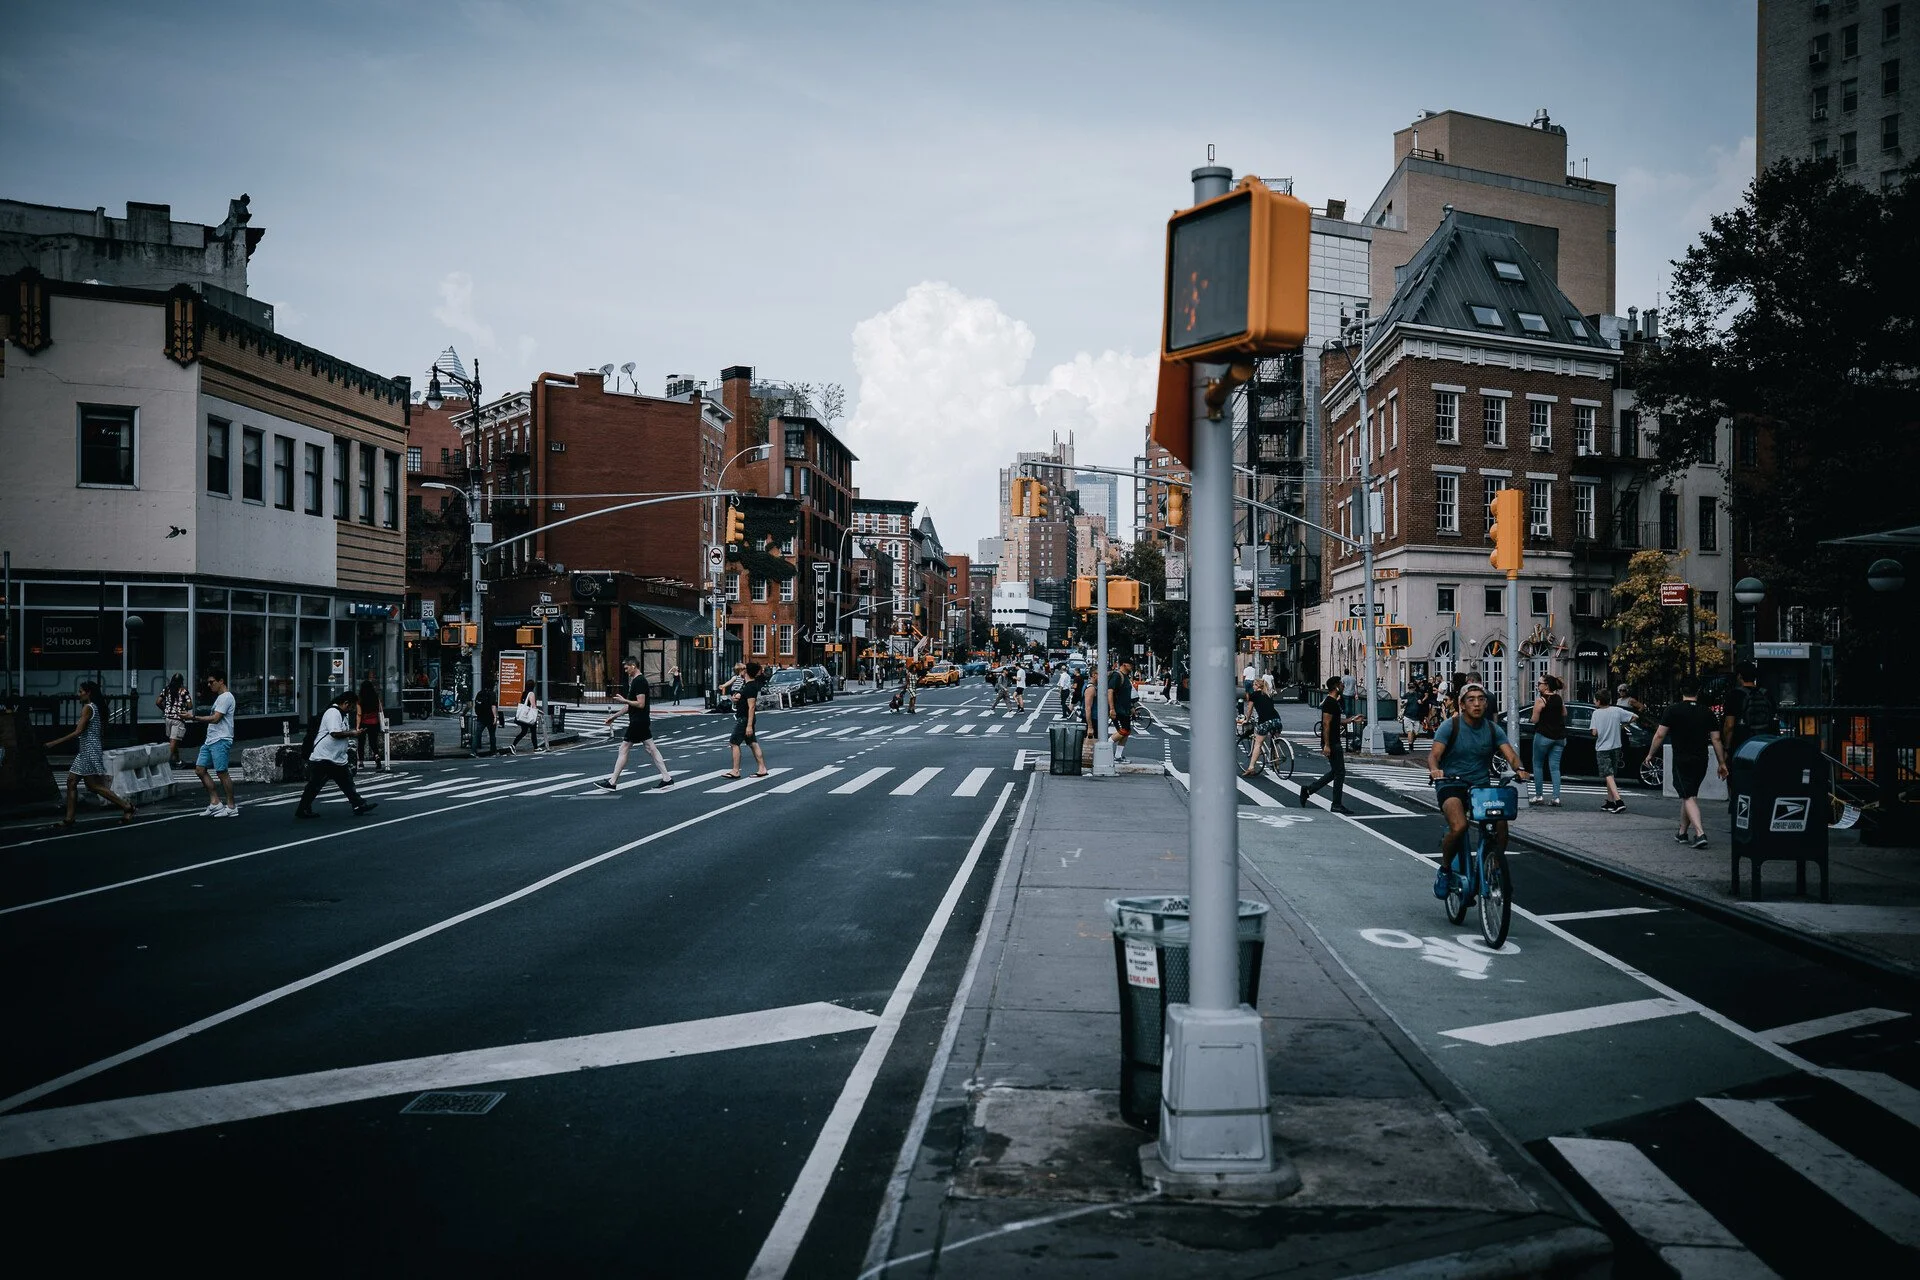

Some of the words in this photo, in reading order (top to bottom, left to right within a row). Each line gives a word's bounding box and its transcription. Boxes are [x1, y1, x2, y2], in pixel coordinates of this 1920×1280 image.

[423, 609, 434, 617] 20
[46, 626, 72, 634] open
[46, 637, 58, 646] 24
[62, 636, 91, 646] hours
[1768, 648, 1792, 657] TITAN
[1142, 976, 1157, 985] FINE
